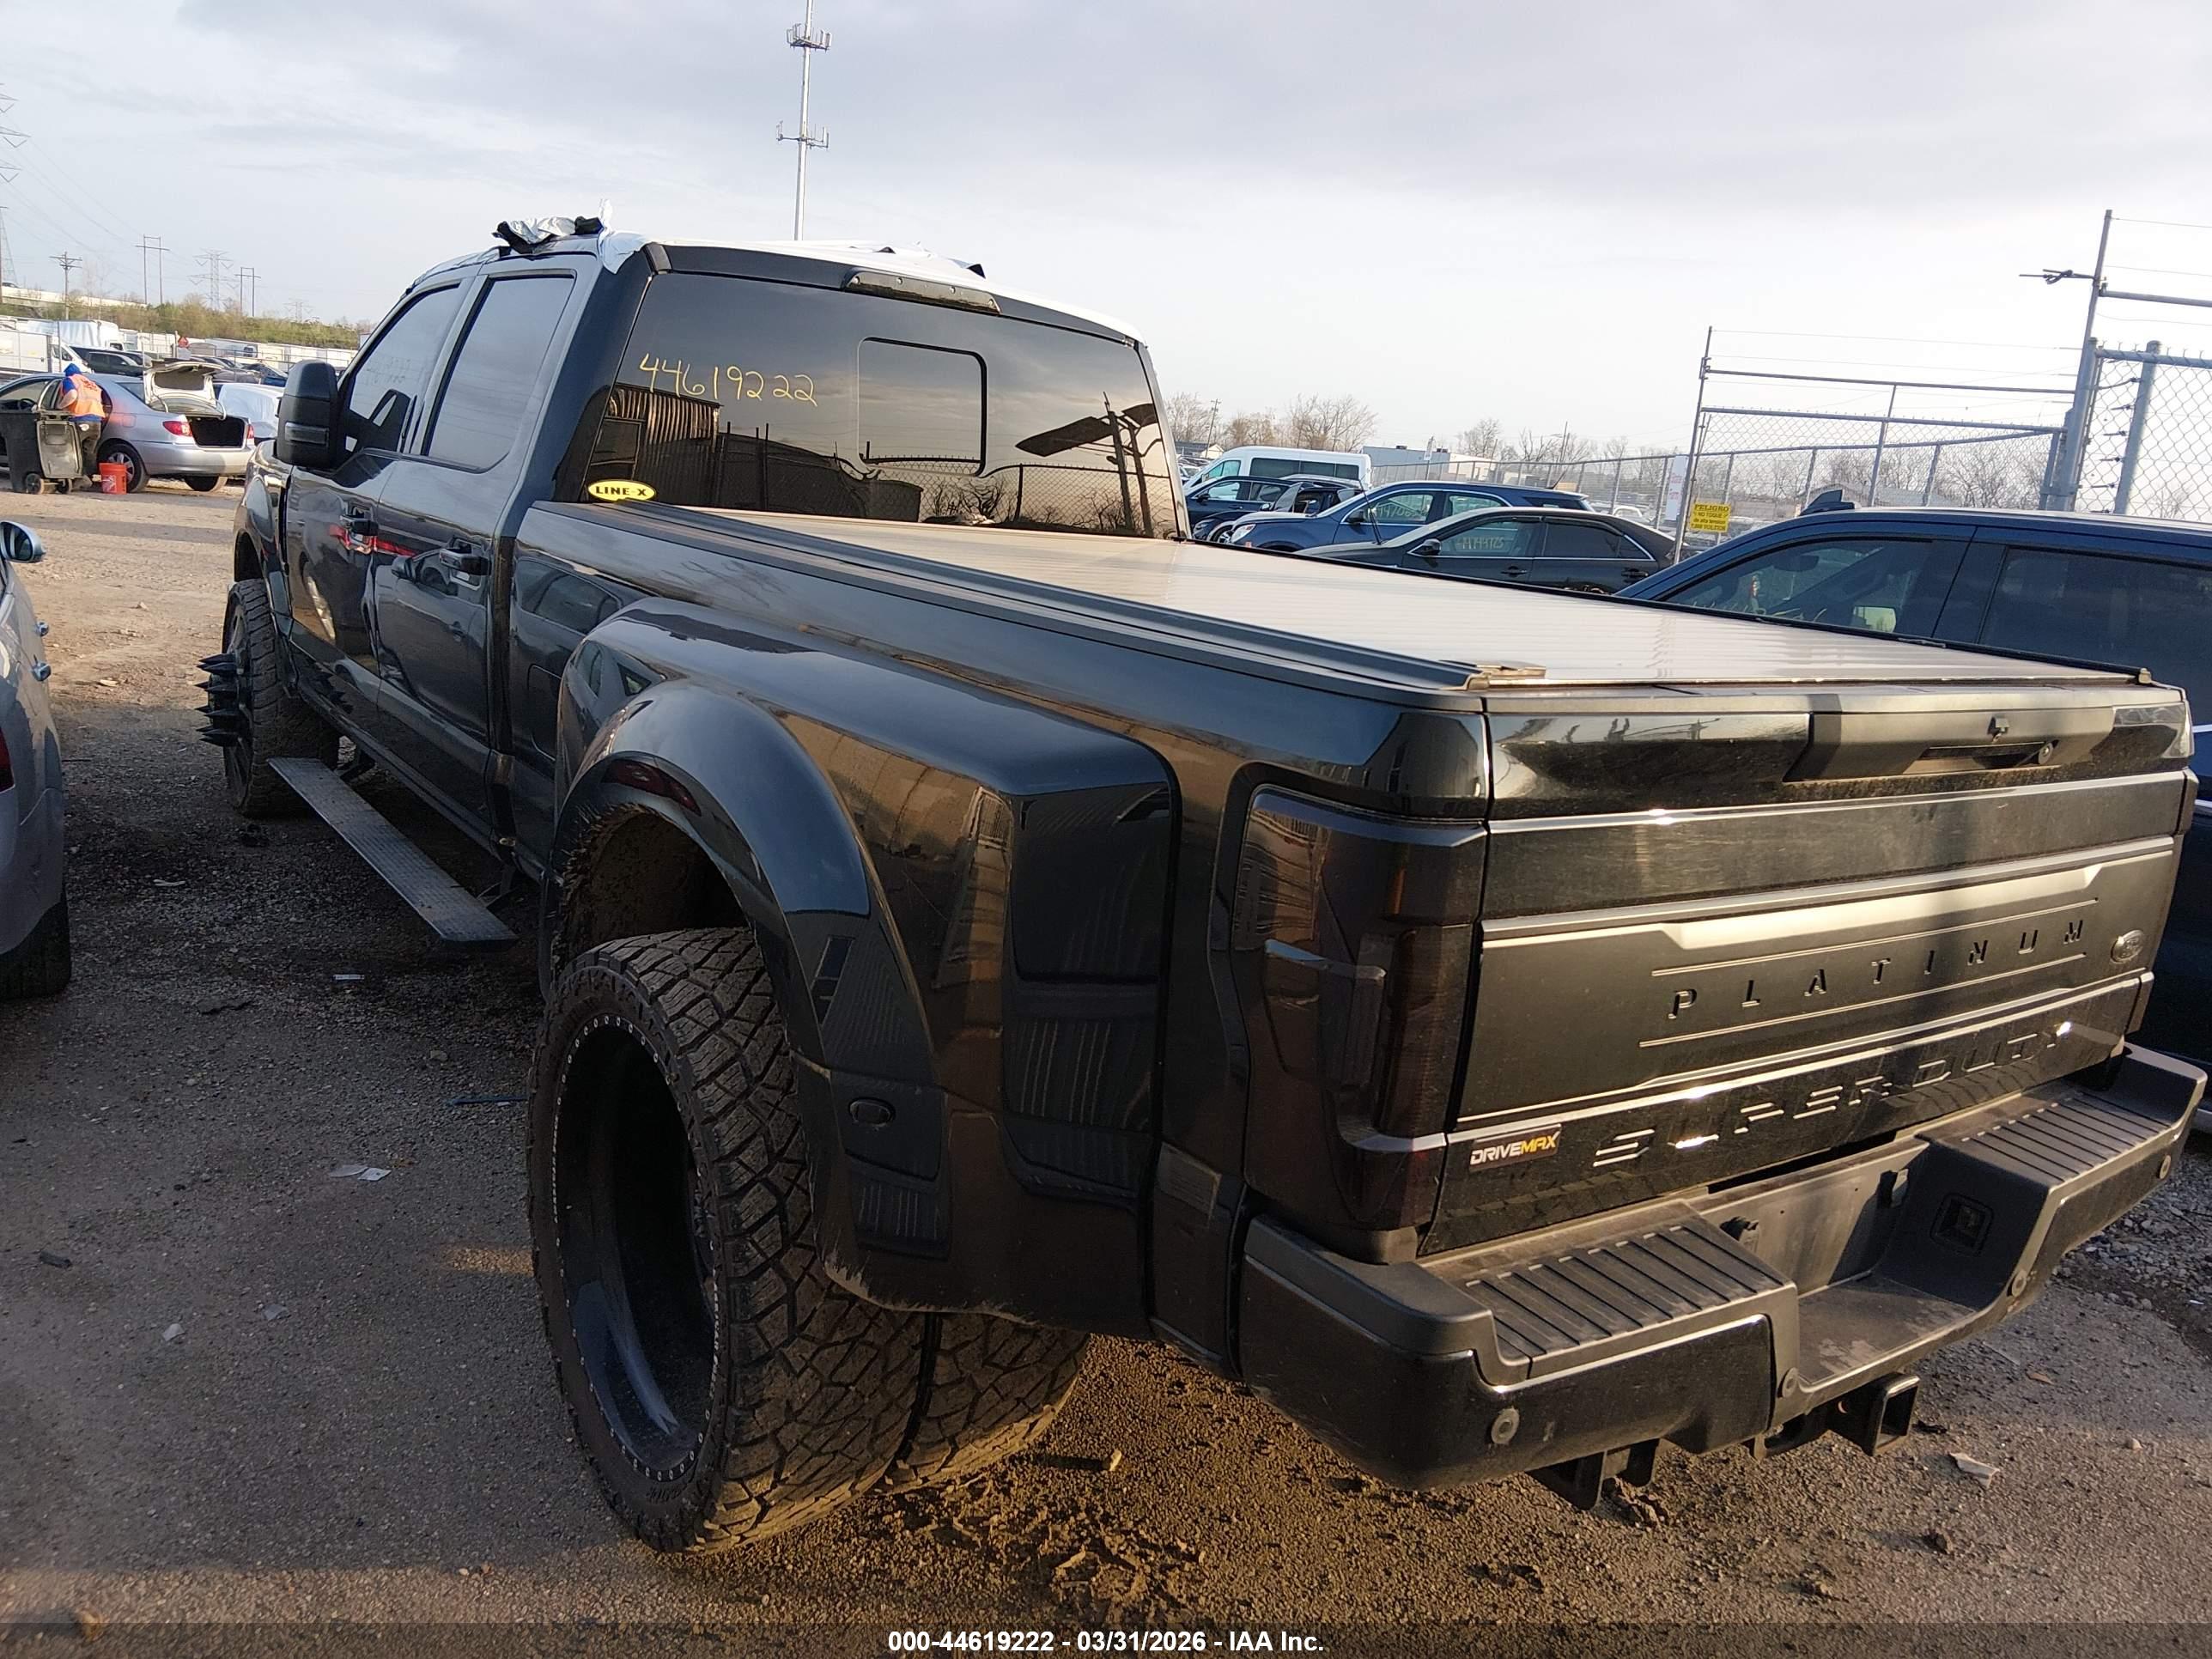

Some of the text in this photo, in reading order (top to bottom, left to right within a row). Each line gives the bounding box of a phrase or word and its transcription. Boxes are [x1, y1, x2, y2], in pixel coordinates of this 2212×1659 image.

[639, 353, 817, 406] 44619222
[595, 486, 647, 496] LINE-X
[1668, 920, 2083, 1019] PLATINUM
[1469, 1130, 1561, 1165] DRIVEMAX
